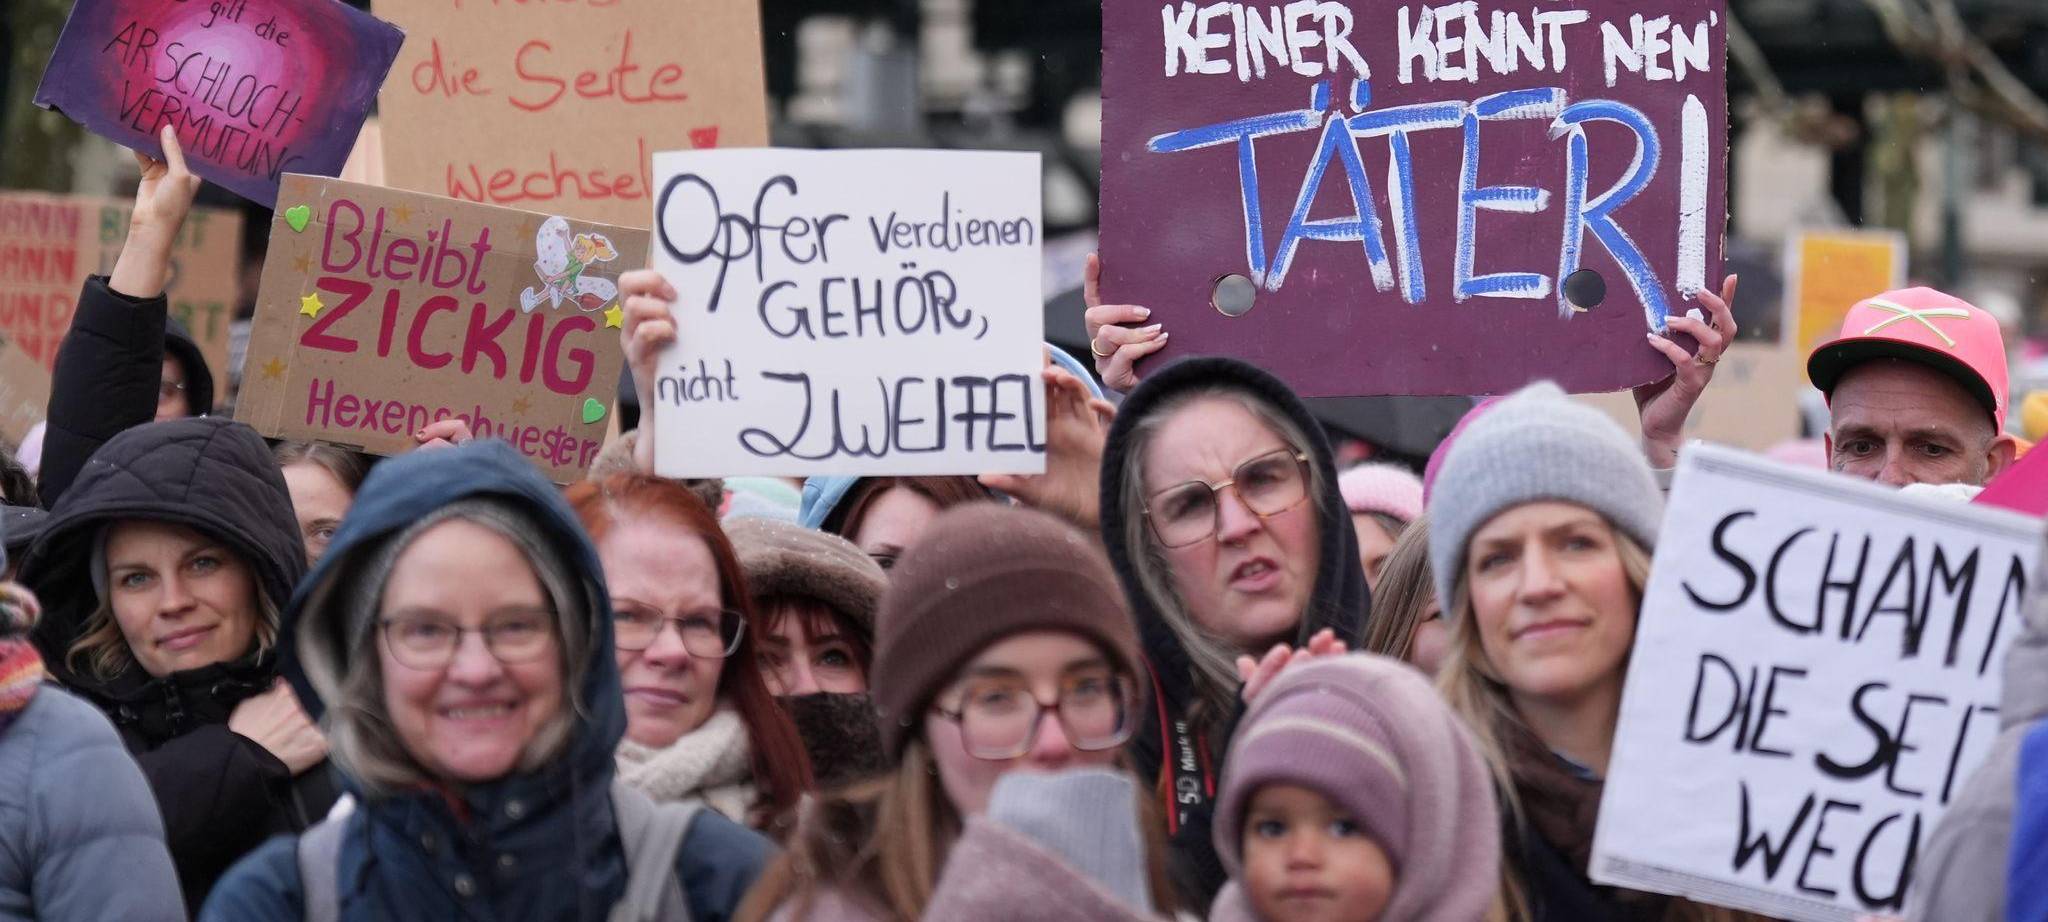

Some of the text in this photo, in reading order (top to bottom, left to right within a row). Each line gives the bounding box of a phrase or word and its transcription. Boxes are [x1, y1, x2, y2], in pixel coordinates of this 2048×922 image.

[254, 15, 289, 48] die
[412, 27, 688, 113] die Seite
[1162, 1, 1719, 88] KEINER KENNT NEN'
[321, 199, 492, 295] Bleibt
[656, 172, 1033, 313] Opfer verdienen
[1145, 78, 1710, 336] TÄTER!
[300, 277, 597, 395] ZICKIG
[757, 261, 989, 340] GEHÖR,
[657, 358, 1047, 460] nicht ZWEIFEL
[1681, 510, 1981, 667] SCHAM
[1683, 653, 2000, 805] DIE SEI
[1176, 776, 1202, 805] 5D
